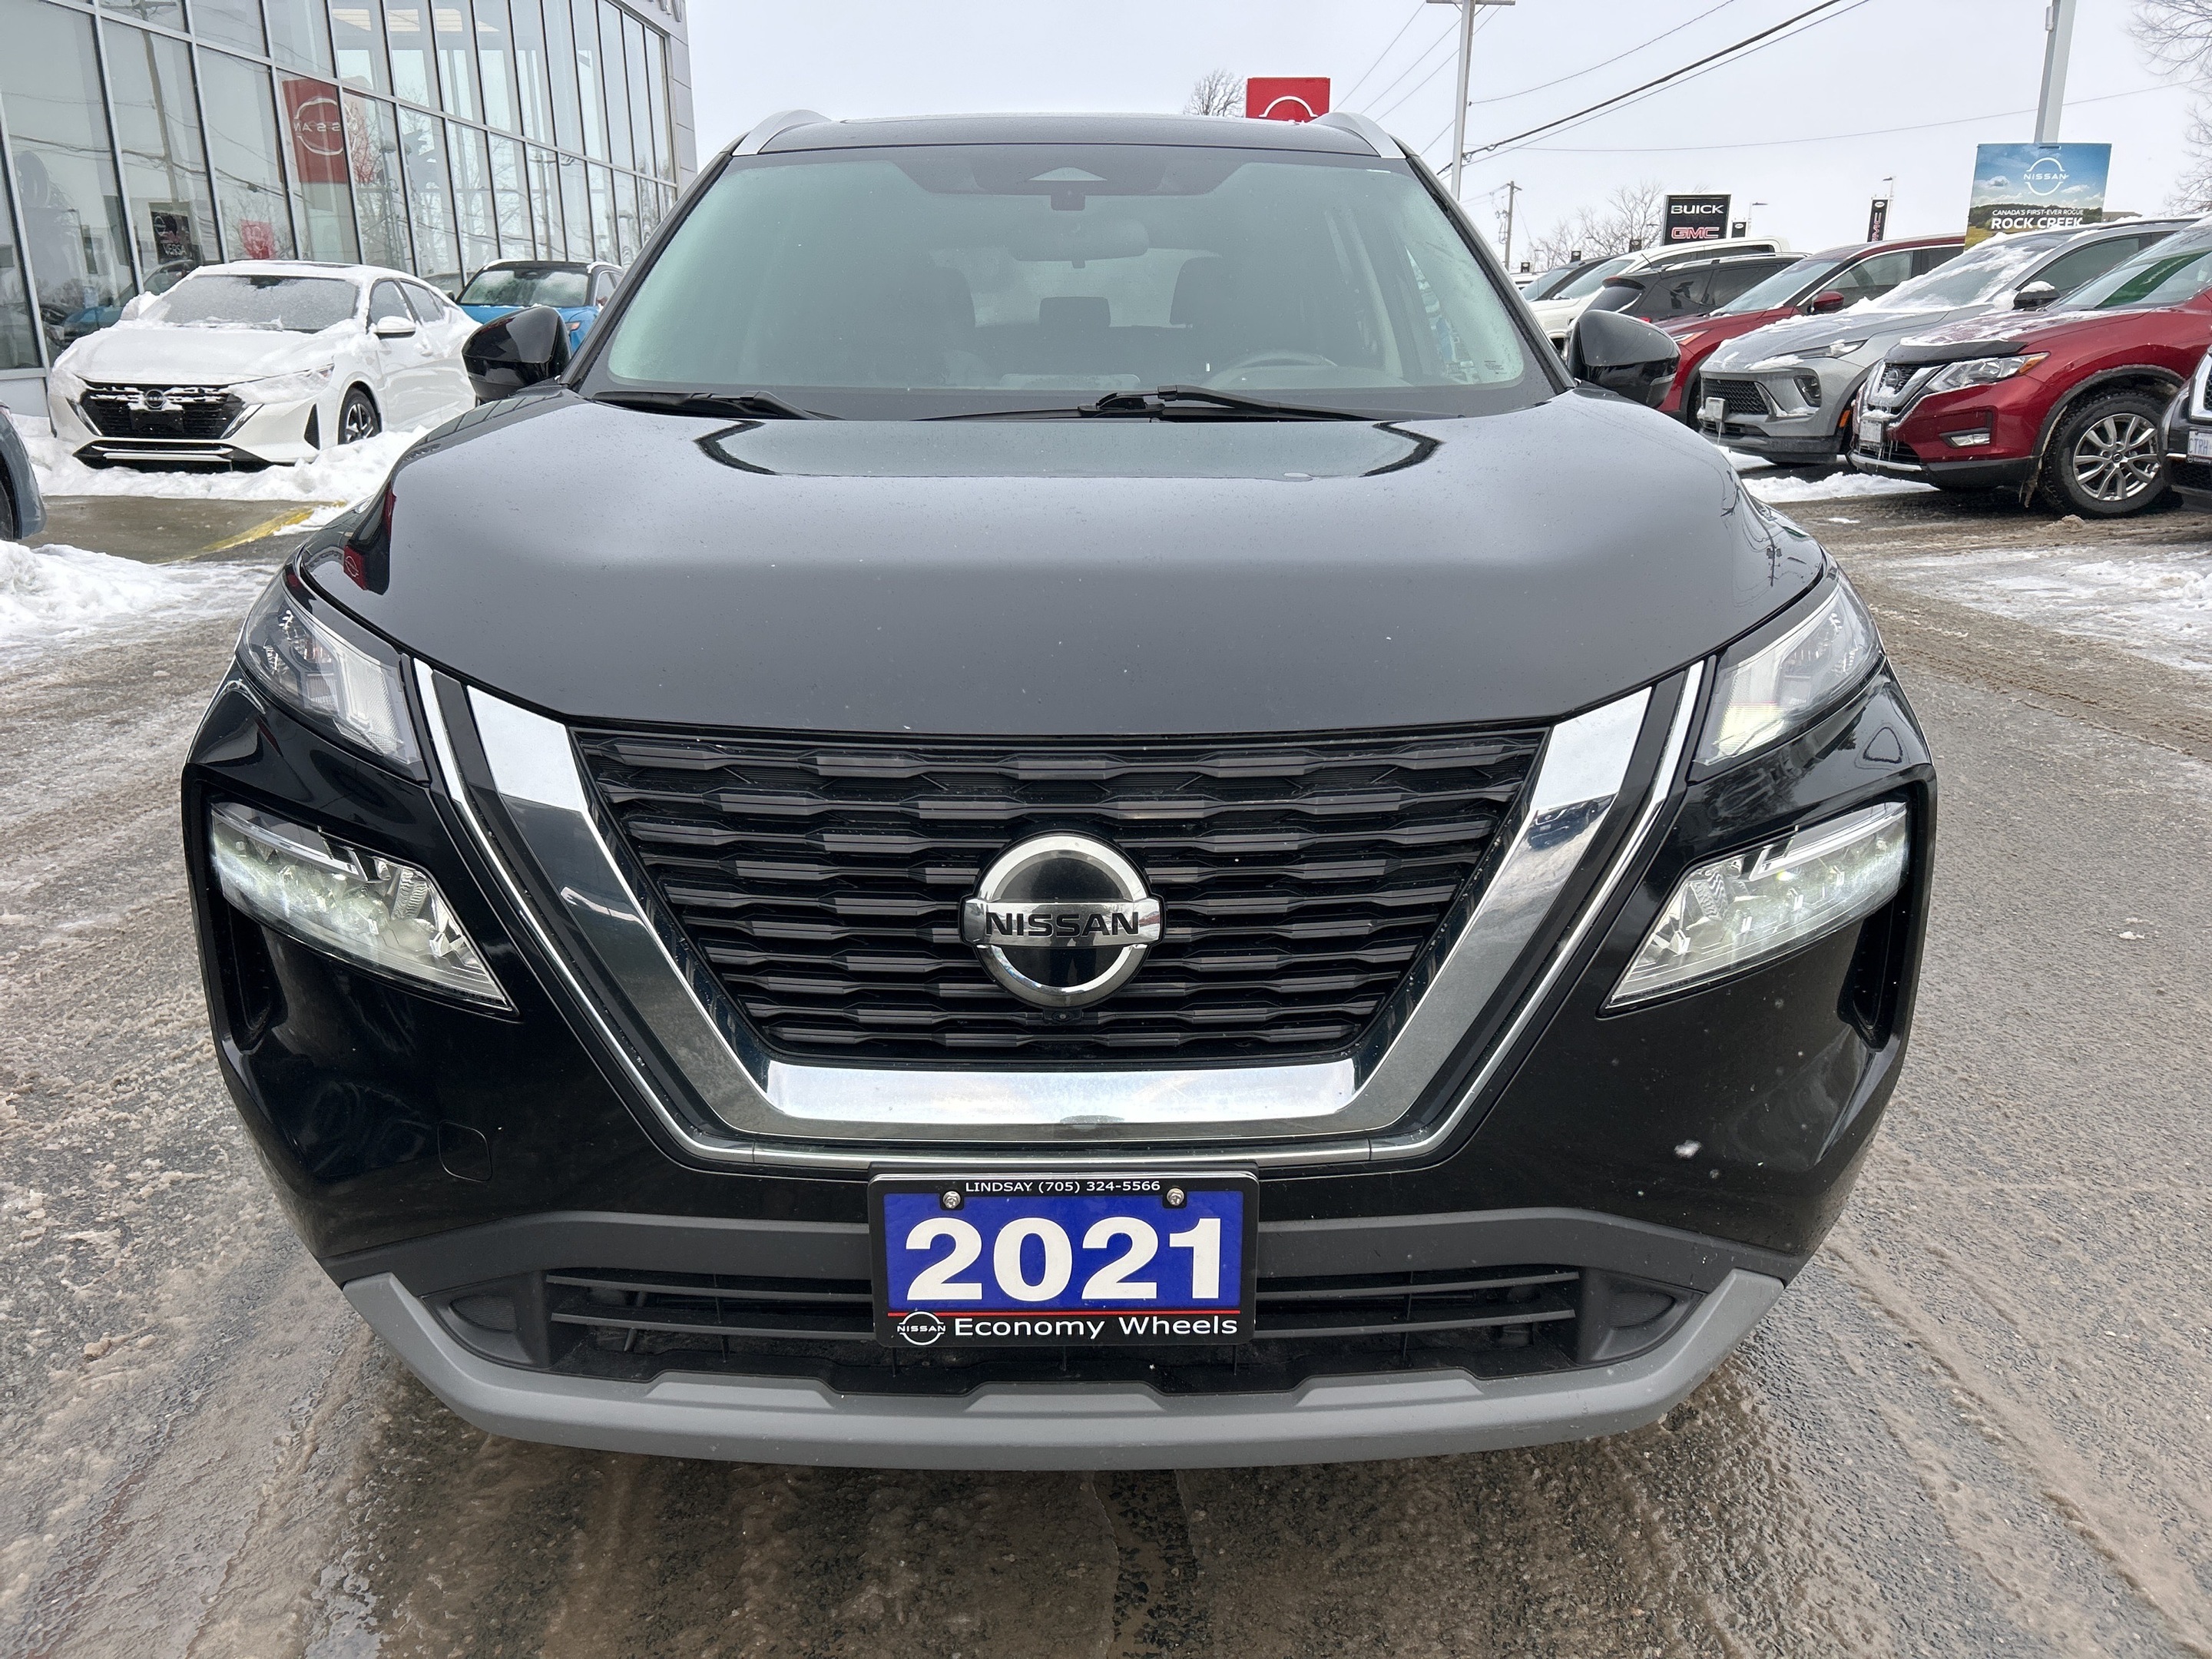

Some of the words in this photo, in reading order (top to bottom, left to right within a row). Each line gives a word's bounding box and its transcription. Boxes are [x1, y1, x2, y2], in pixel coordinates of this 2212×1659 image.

[1671, 204, 1724, 214] BUICK
[1991, 217, 2035, 229] ROCK
[2037, 217, 2084, 229] CREEK
[1671, 227, 1720, 239] GMC
[985, 912, 1139, 937] NISSAN
[965, 1181, 1033, 1192] LINDSAY
[1038, 1181, 1081, 1194] (705)
[1086, 1181, 1161, 1191] 324-5566
[906, 1217, 1221, 1301] 2021
[955, 1317, 1105, 1339] Economy
[1118, 1315, 1238, 1335] Wheels
